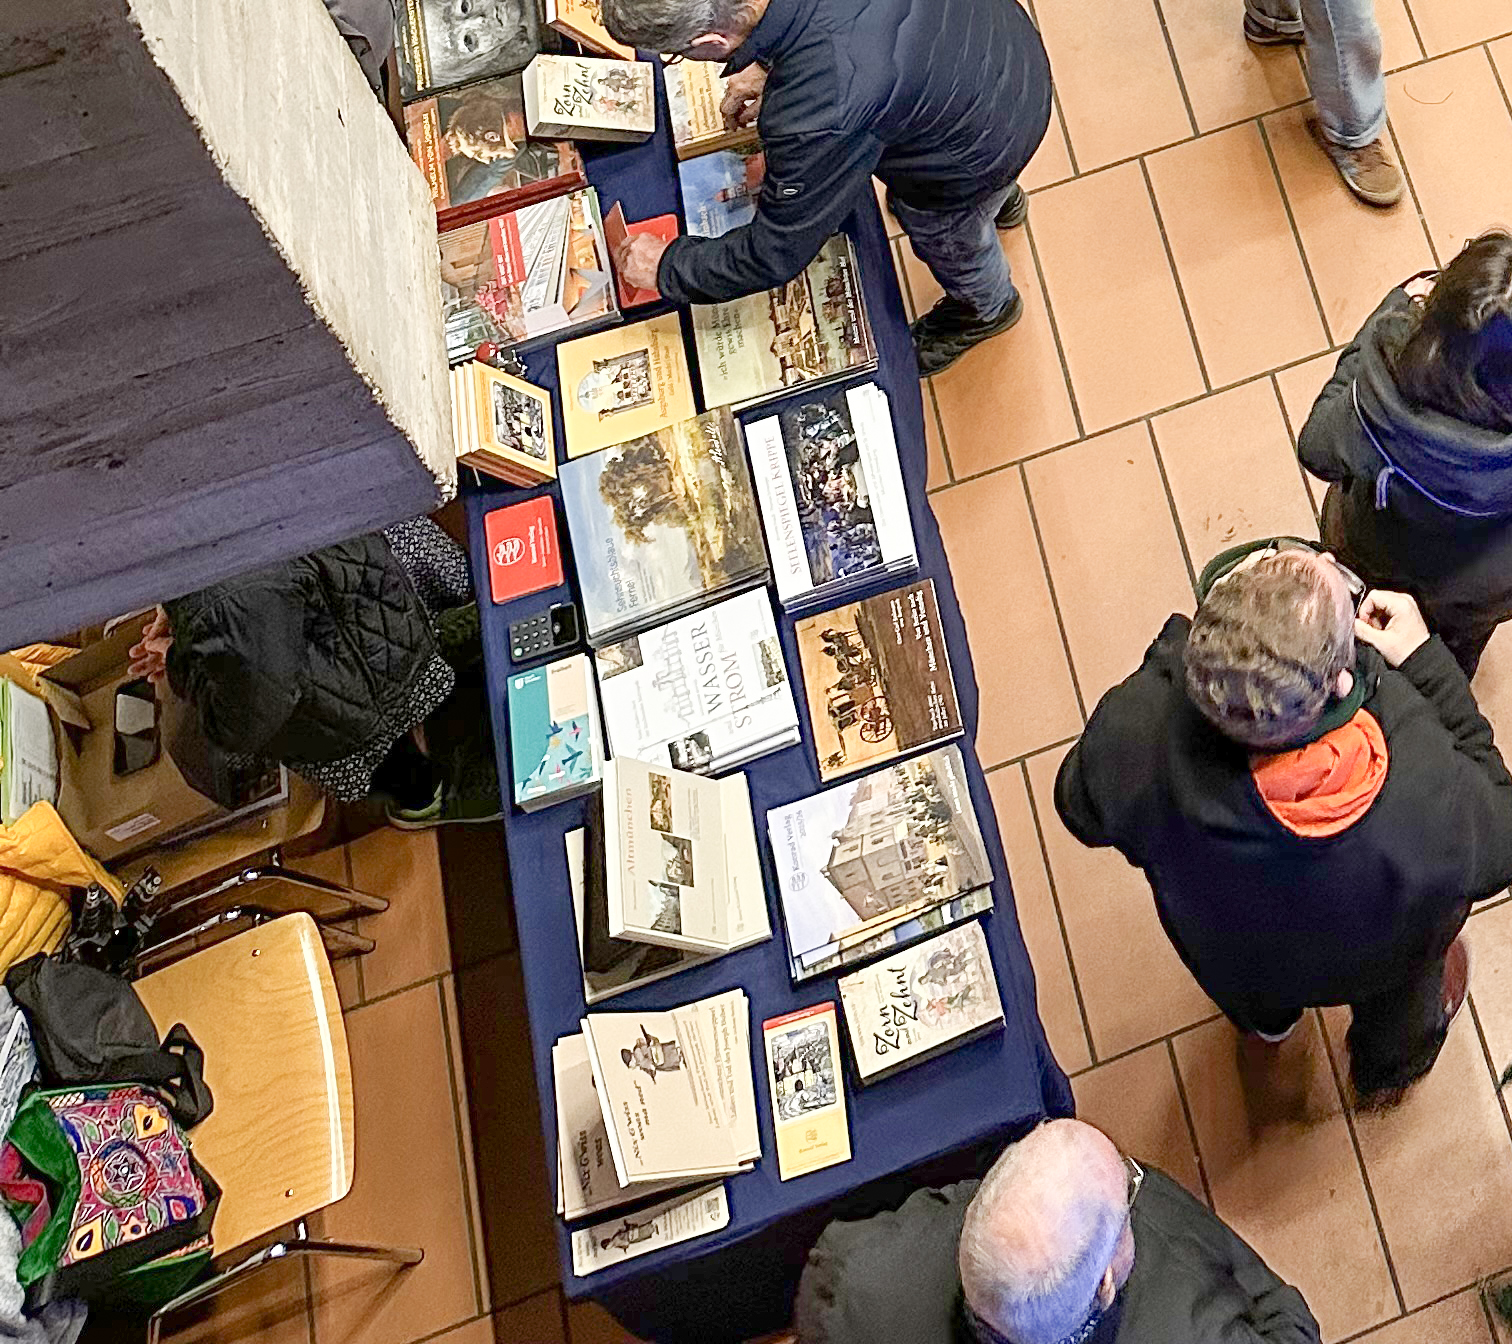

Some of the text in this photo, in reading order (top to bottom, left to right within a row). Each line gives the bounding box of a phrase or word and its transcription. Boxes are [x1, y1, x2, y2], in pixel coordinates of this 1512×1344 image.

[765, 434, 783, 480] KRIPPE
[691, 621, 725, 716] WASSER
[722, 650, 752, 731] STROM
